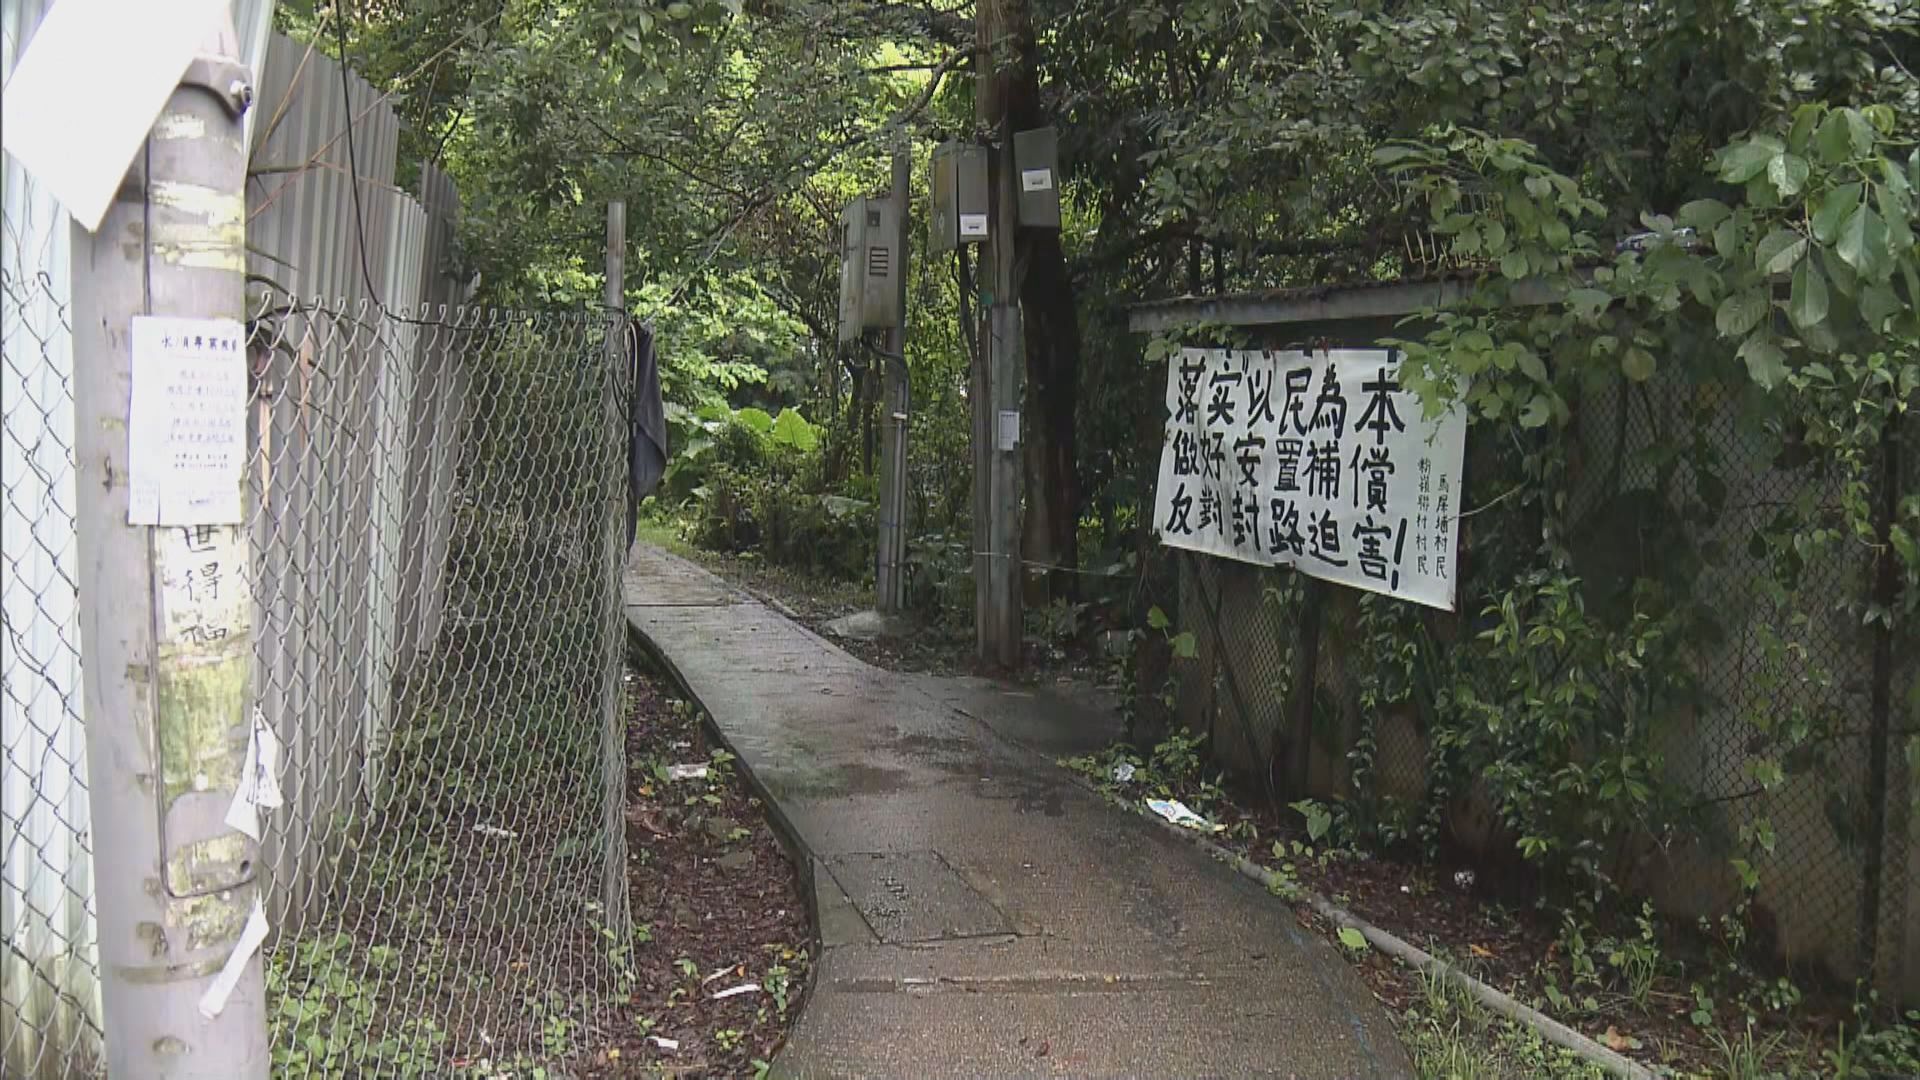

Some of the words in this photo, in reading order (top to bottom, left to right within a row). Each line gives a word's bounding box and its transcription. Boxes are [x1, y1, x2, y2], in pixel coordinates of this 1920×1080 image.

[1172, 429, 1395, 514] 做好安置補償
[1434, 474, 1449, 580] 馬屎埔村民
